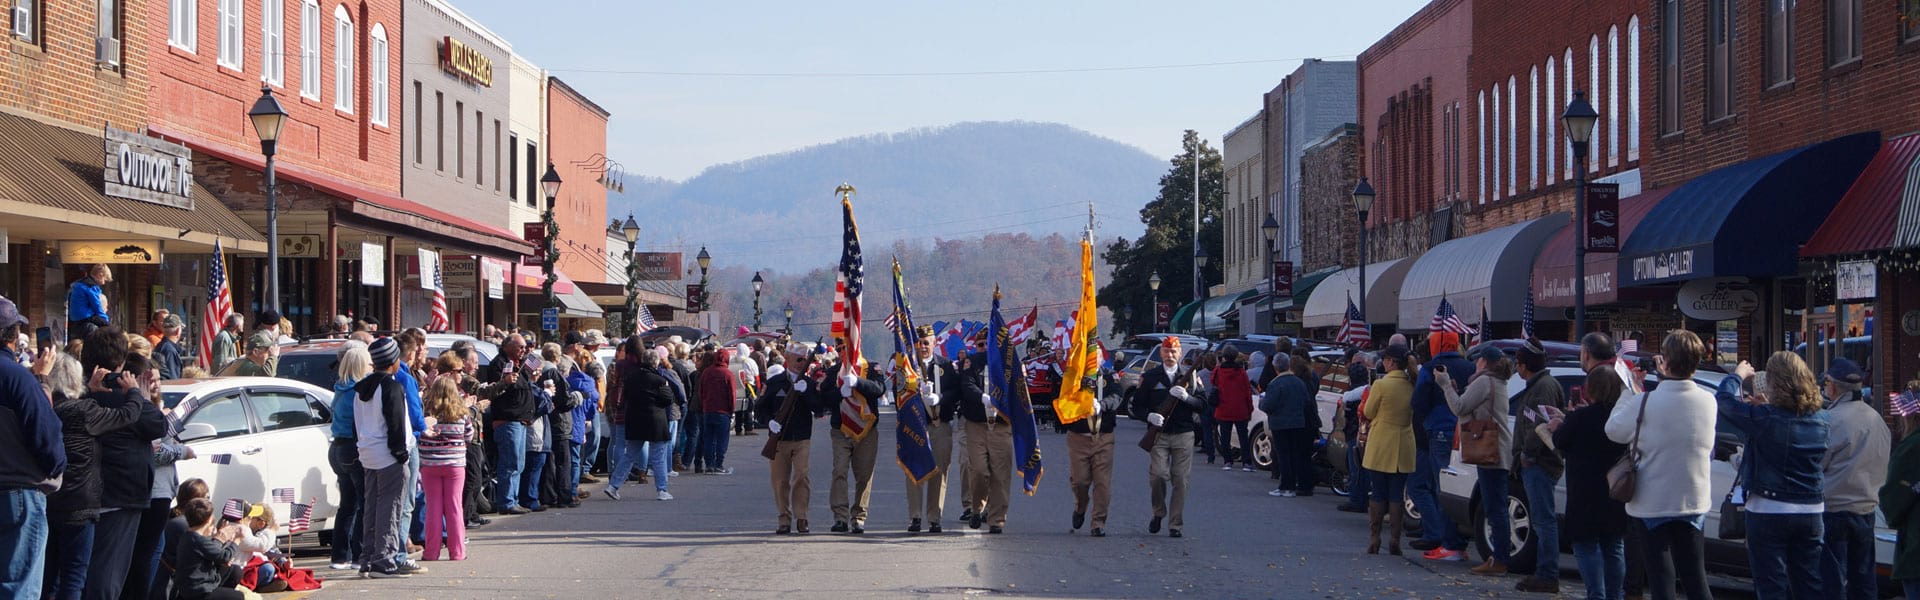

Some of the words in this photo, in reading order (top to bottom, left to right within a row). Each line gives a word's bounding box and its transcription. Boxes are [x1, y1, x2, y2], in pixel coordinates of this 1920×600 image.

[450, 37, 473, 76] WELLS
[473, 50, 493, 87] FARGO
[175, 156, 190, 197] 76
[133, 253, 144, 262] 76
[1633, 256, 1656, 281] UPTOWN
[1669, 249, 1694, 276] GALLERY
[1596, 272, 1611, 293] MADE
[1693, 300, 1739, 311] GALLERY
[903, 425, 925, 446] WARS
